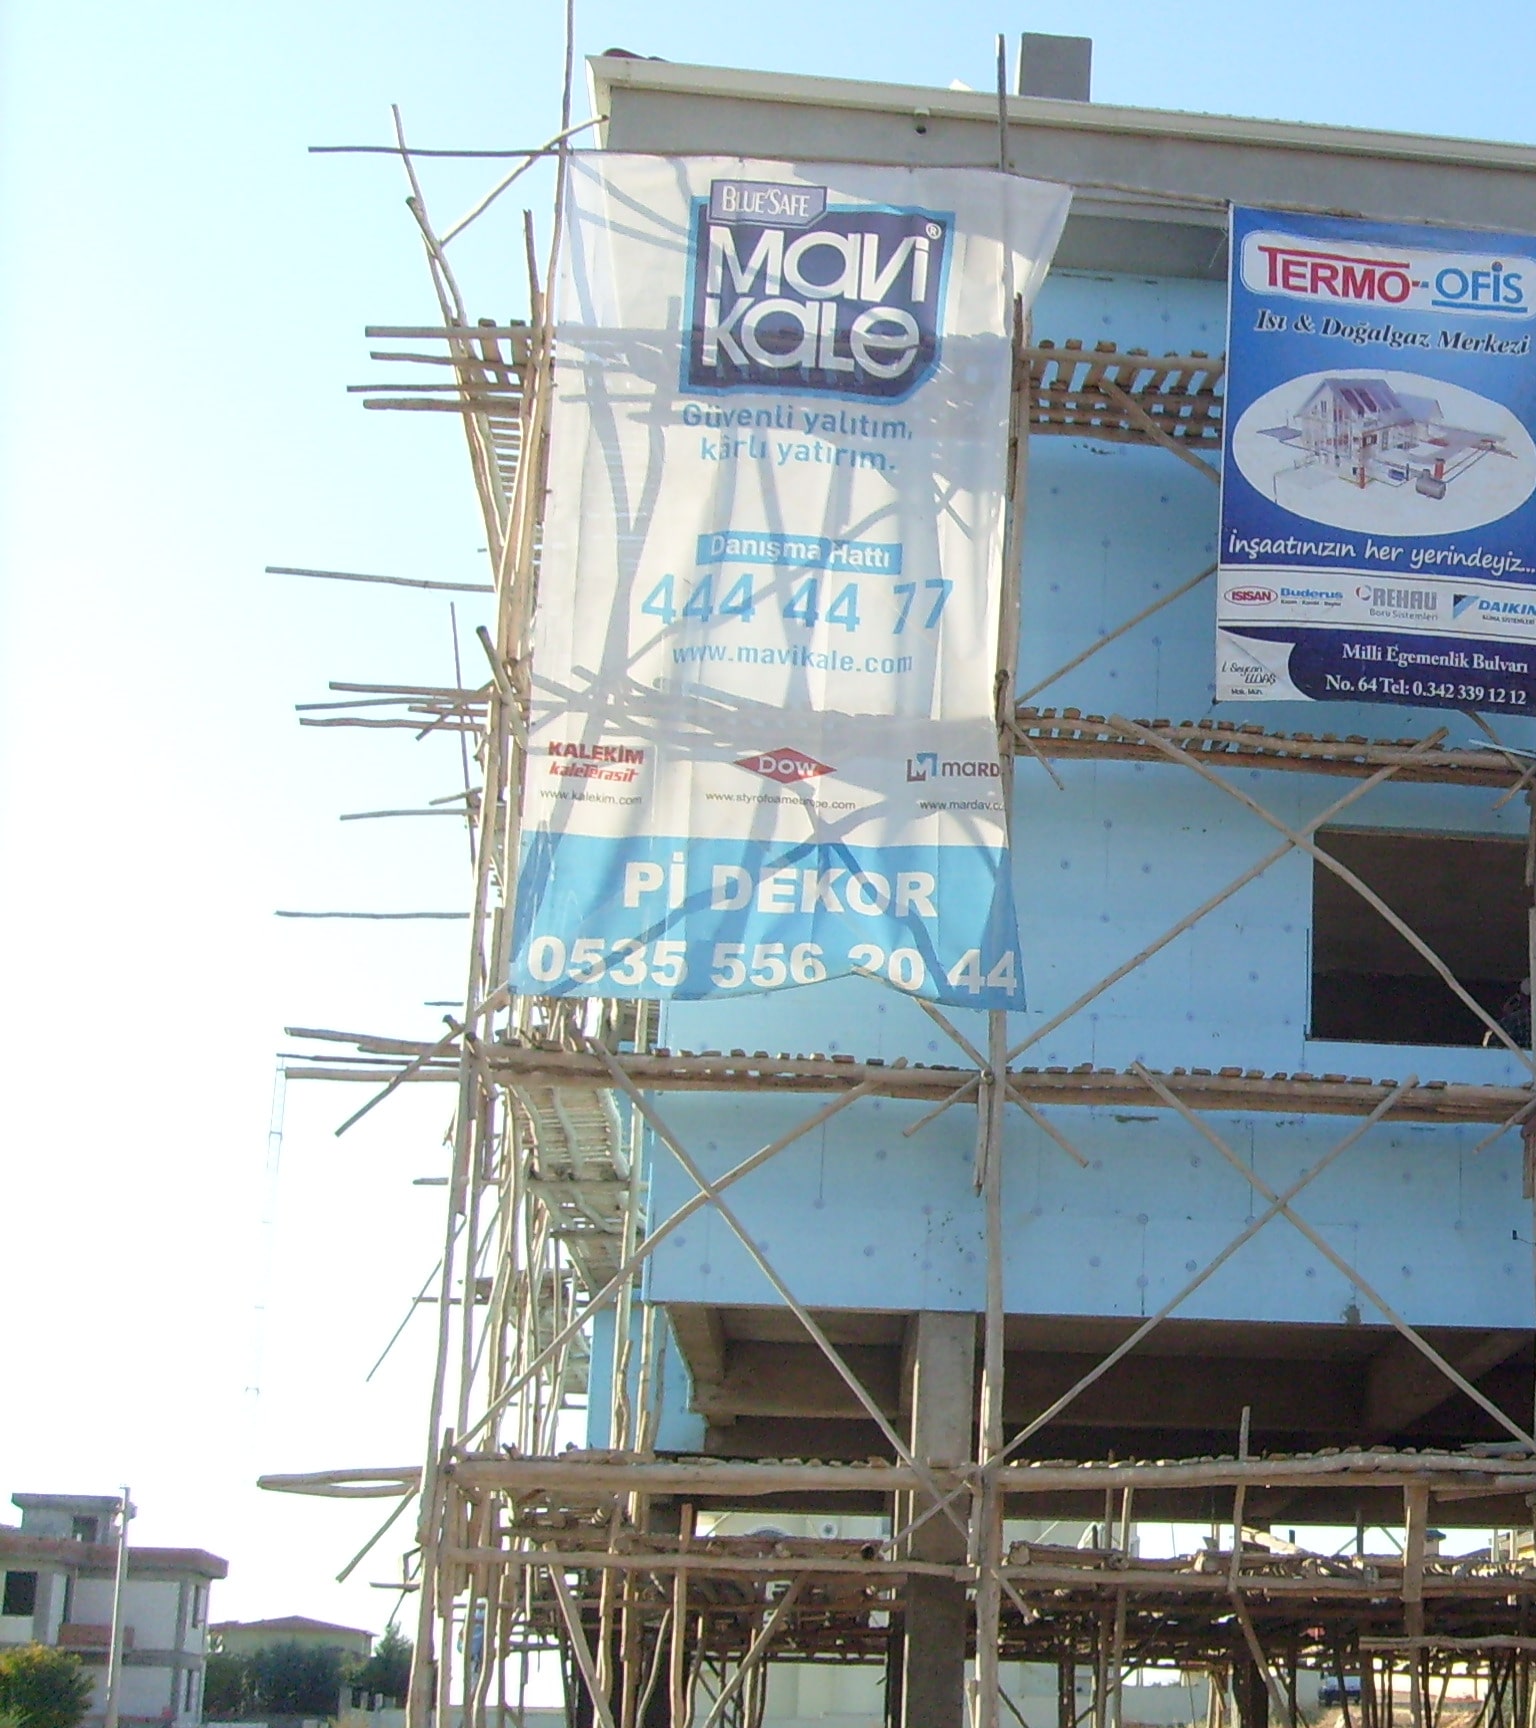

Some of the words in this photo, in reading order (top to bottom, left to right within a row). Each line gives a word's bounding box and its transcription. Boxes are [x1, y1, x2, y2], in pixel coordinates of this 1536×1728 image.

[1255, 309, 1287, 331] Isı
[1294, 313, 1315, 333] &
[1322, 316, 1430, 348] Doğalgaz
[1437, 330, 1531, 356] Merkezi
[682, 403, 793, 430] Güvenli
[803, 411, 913, 441] yalıtım,
[701, 434, 766, 461] kârlı
[777, 440, 896, 471] yatırım.
[711, 535, 821, 564] Danışma
[828, 542, 890, 568] Hattı
[1364, 539, 1404, 561] her
[1410, 544, 1536, 577] yerindeyiz...
[641, 574, 756, 625] 444
[782, 578, 861, 633] 44
[892, 578, 954, 635] 77
[1280, 587, 1344, 599] Buderus
[1372, 588, 1438, 611] REHAU
[1369, 608, 1391, 617] Boru
[1392, 610, 1438, 621] Sistemleri
[673, 644, 913, 675] www.mavikale.com
[1342, 643, 1383, 662] Milli
[1386, 644, 1470, 670] Egemenlik
[1472, 653, 1529, 674] Bulvarı
[1325, 674, 1355, 692] No.
[1357, 676, 1378, 693] 64
[1379, 675, 1410, 695] Tel:
[1412, 680, 1454, 699] 0.342
[1457, 683, 1484, 701] 339
[1488, 686, 1506, 703] 12
[1509, 688, 1527, 705] 12
[548, 741, 645, 765] KALEKİM
[757, 755, 817, 777] DOW
[540, 789, 642, 806] www.kalekim.com
[623, 851, 685, 910] Pİ
[710, 864, 938, 918] DEKOR
[527, 936, 688, 989] 0535
[711, 942, 827, 989] 556
[848, 944, 925, 991] 20
[947, 949, 1018, 997] 44
